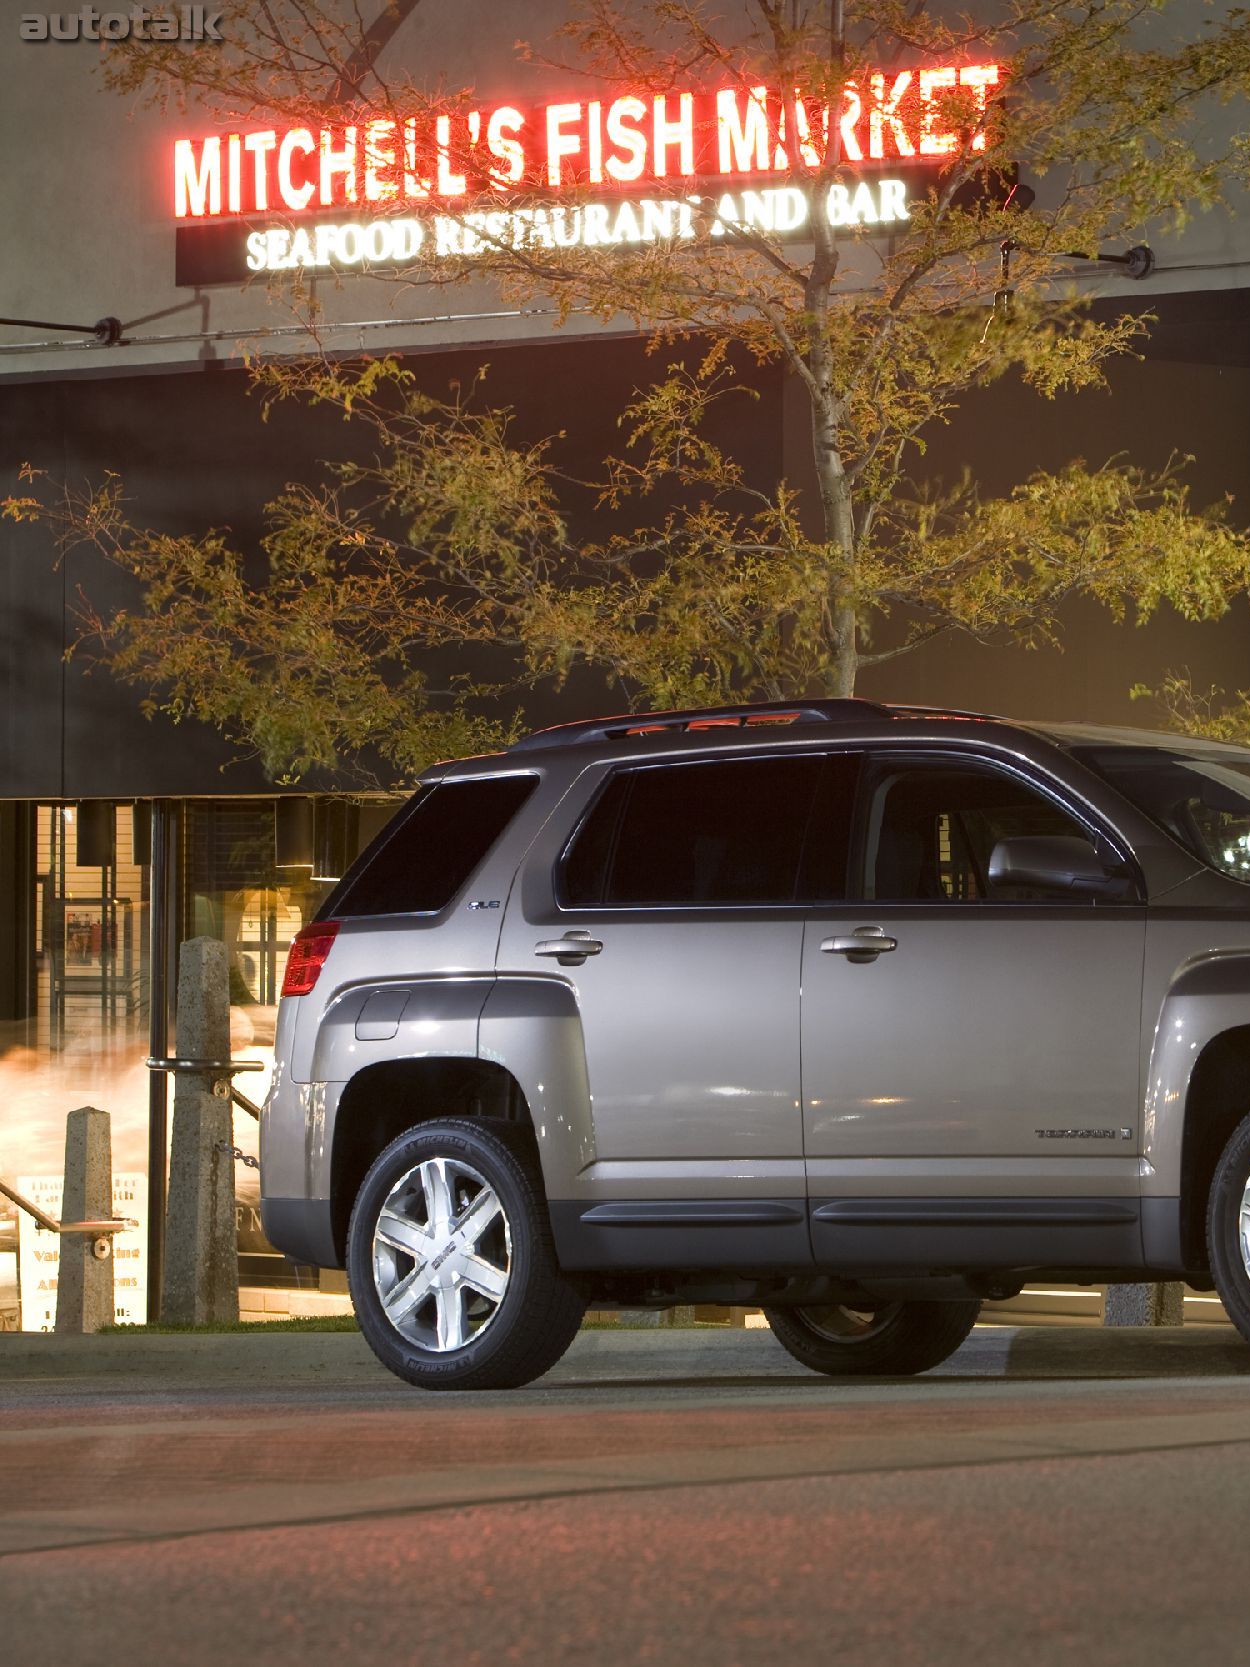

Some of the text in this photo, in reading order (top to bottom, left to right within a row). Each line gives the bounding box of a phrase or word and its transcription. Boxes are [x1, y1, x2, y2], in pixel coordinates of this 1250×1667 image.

[175, 65, 998, 217] MITCHELL'S FISH MARKET
[246, 218, 423, 271] SEAFOOD
[709, 188, 808, 236] AND
[826, 180, 911, 226] BAR
